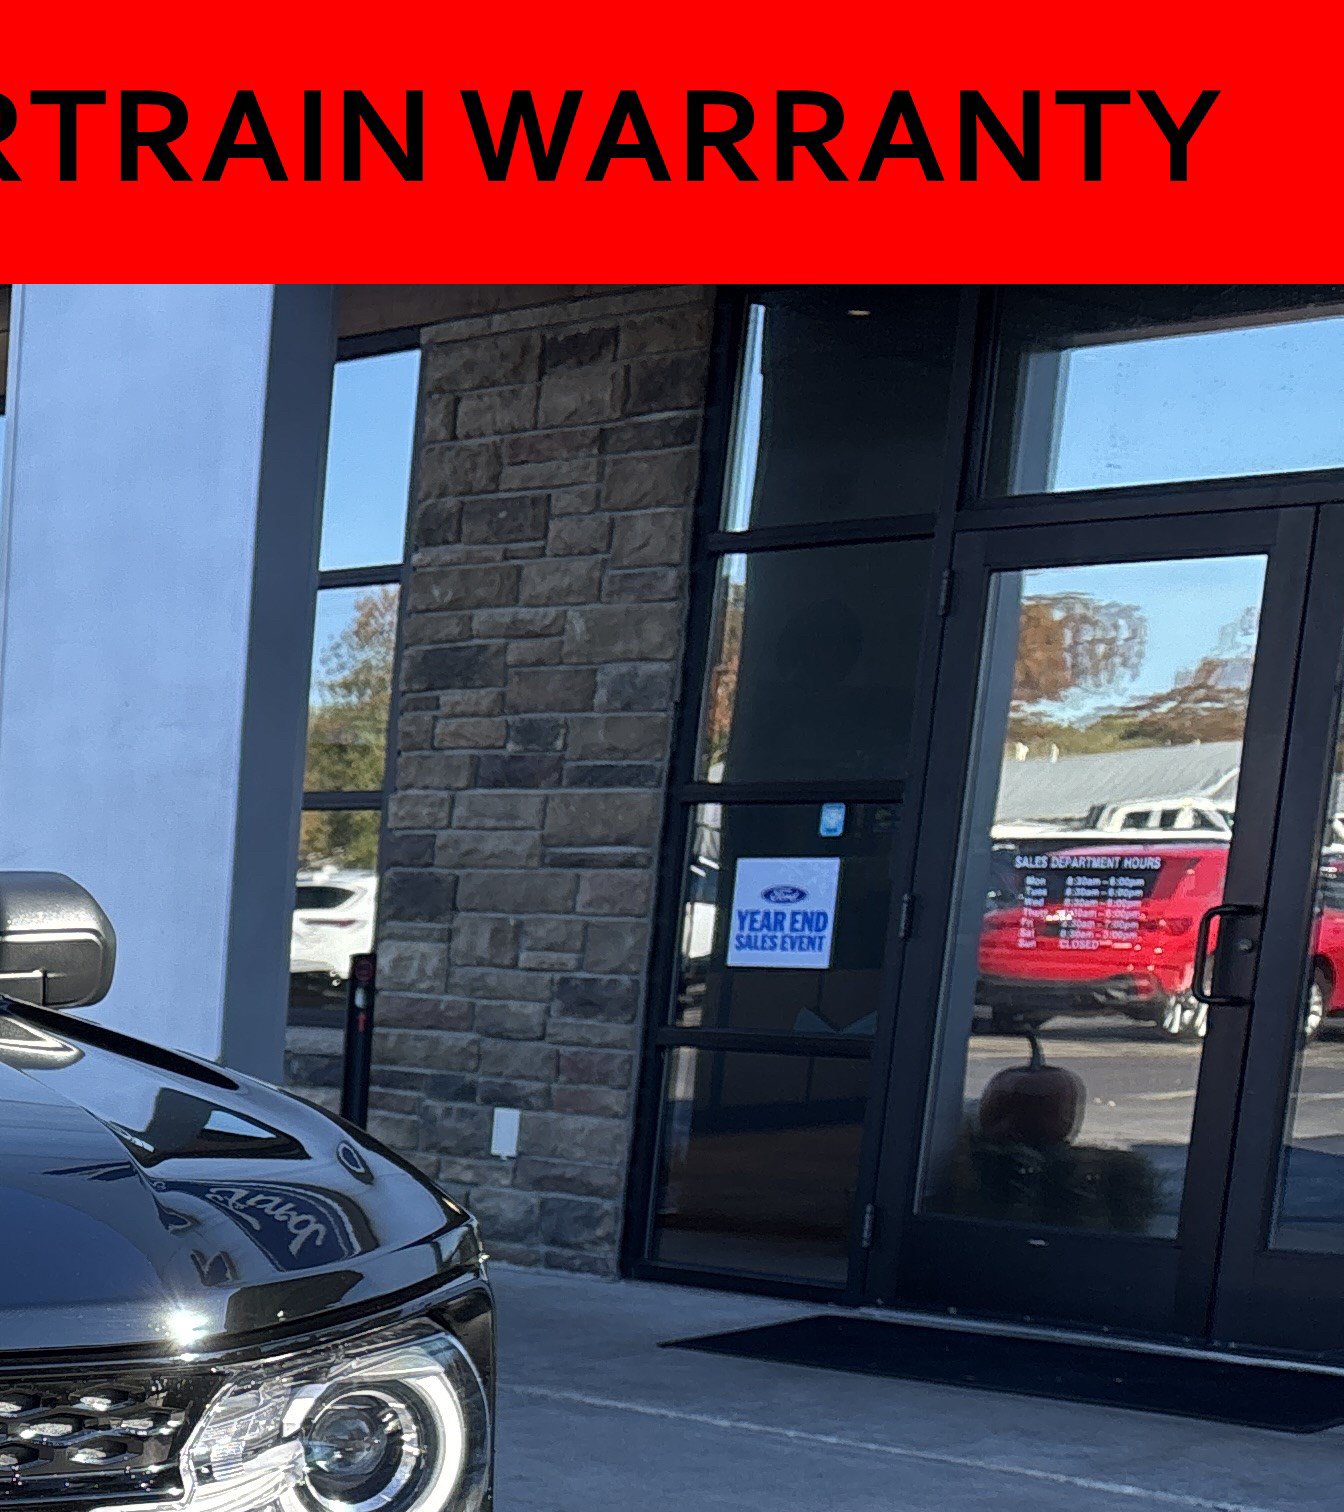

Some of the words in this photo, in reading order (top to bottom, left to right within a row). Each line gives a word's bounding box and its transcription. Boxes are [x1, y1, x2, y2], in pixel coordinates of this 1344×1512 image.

[1015, 855, 1048, 868] SALES
[1050, 856, 1121, 869] DEPARTMENT
[1123, 856, 1162, 869] HOURS
[737, 909, 786, 932] YEAR
[790, 910, 829, 933] END
[735, 933, 778, 951] SALES
[780, 934, 826, 952] EVENT
